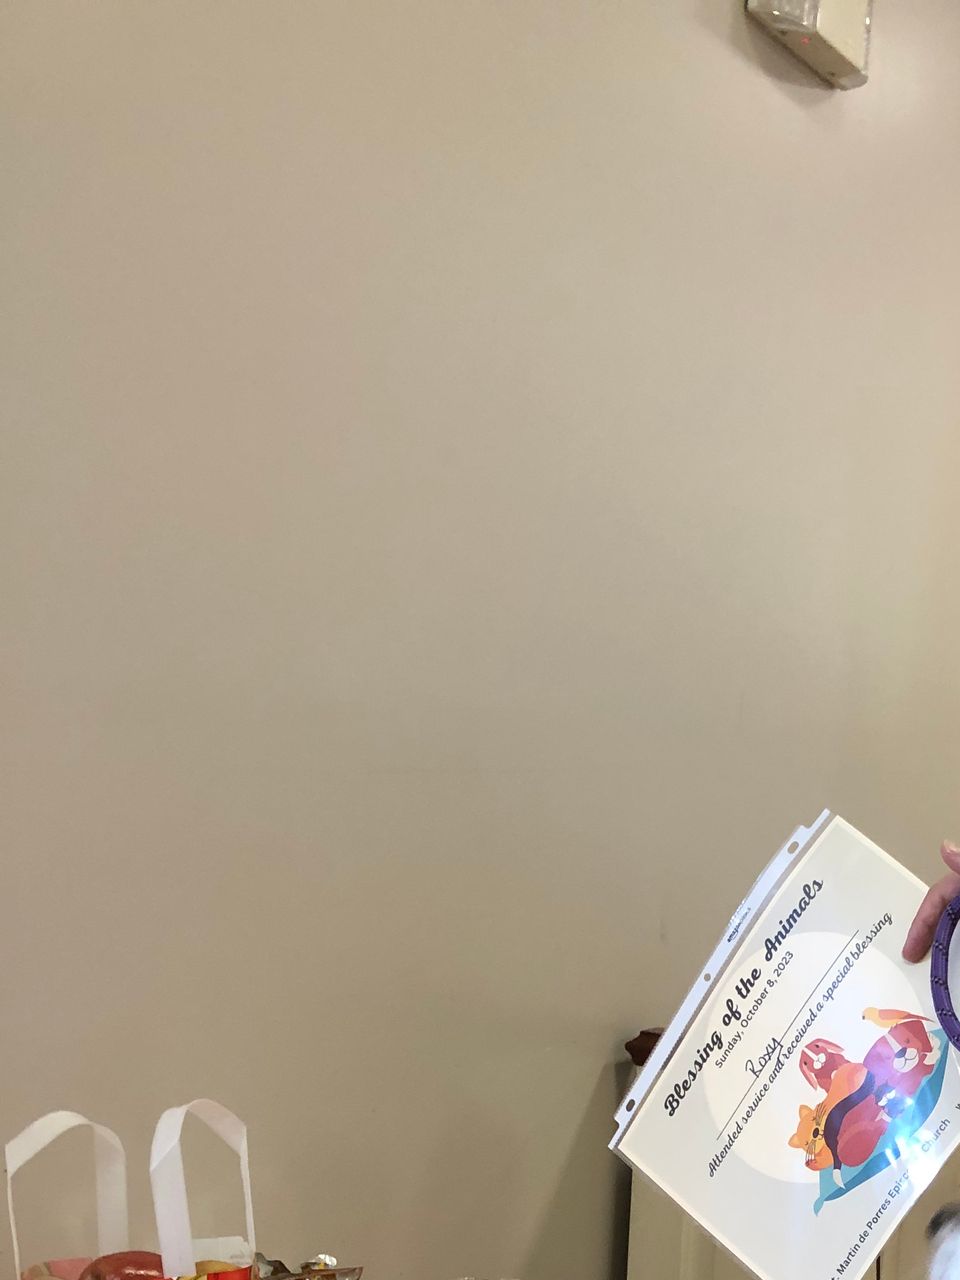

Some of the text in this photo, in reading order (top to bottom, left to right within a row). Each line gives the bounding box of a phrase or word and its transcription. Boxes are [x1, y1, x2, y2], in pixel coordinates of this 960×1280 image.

[664, 879, 824, 1117] Blessing of the Animals
[708, 912, 893, 1178] Attended service and received a special blessing
[714, 950, 794, 1068] Sunday, October 8, 2023
[836, 1243, 861, 1276] Martin
[858, 1230, 870, 1244] de
[866, 1199, 891, 1231] Porres
[921, 1118, 951, 1153] Church
